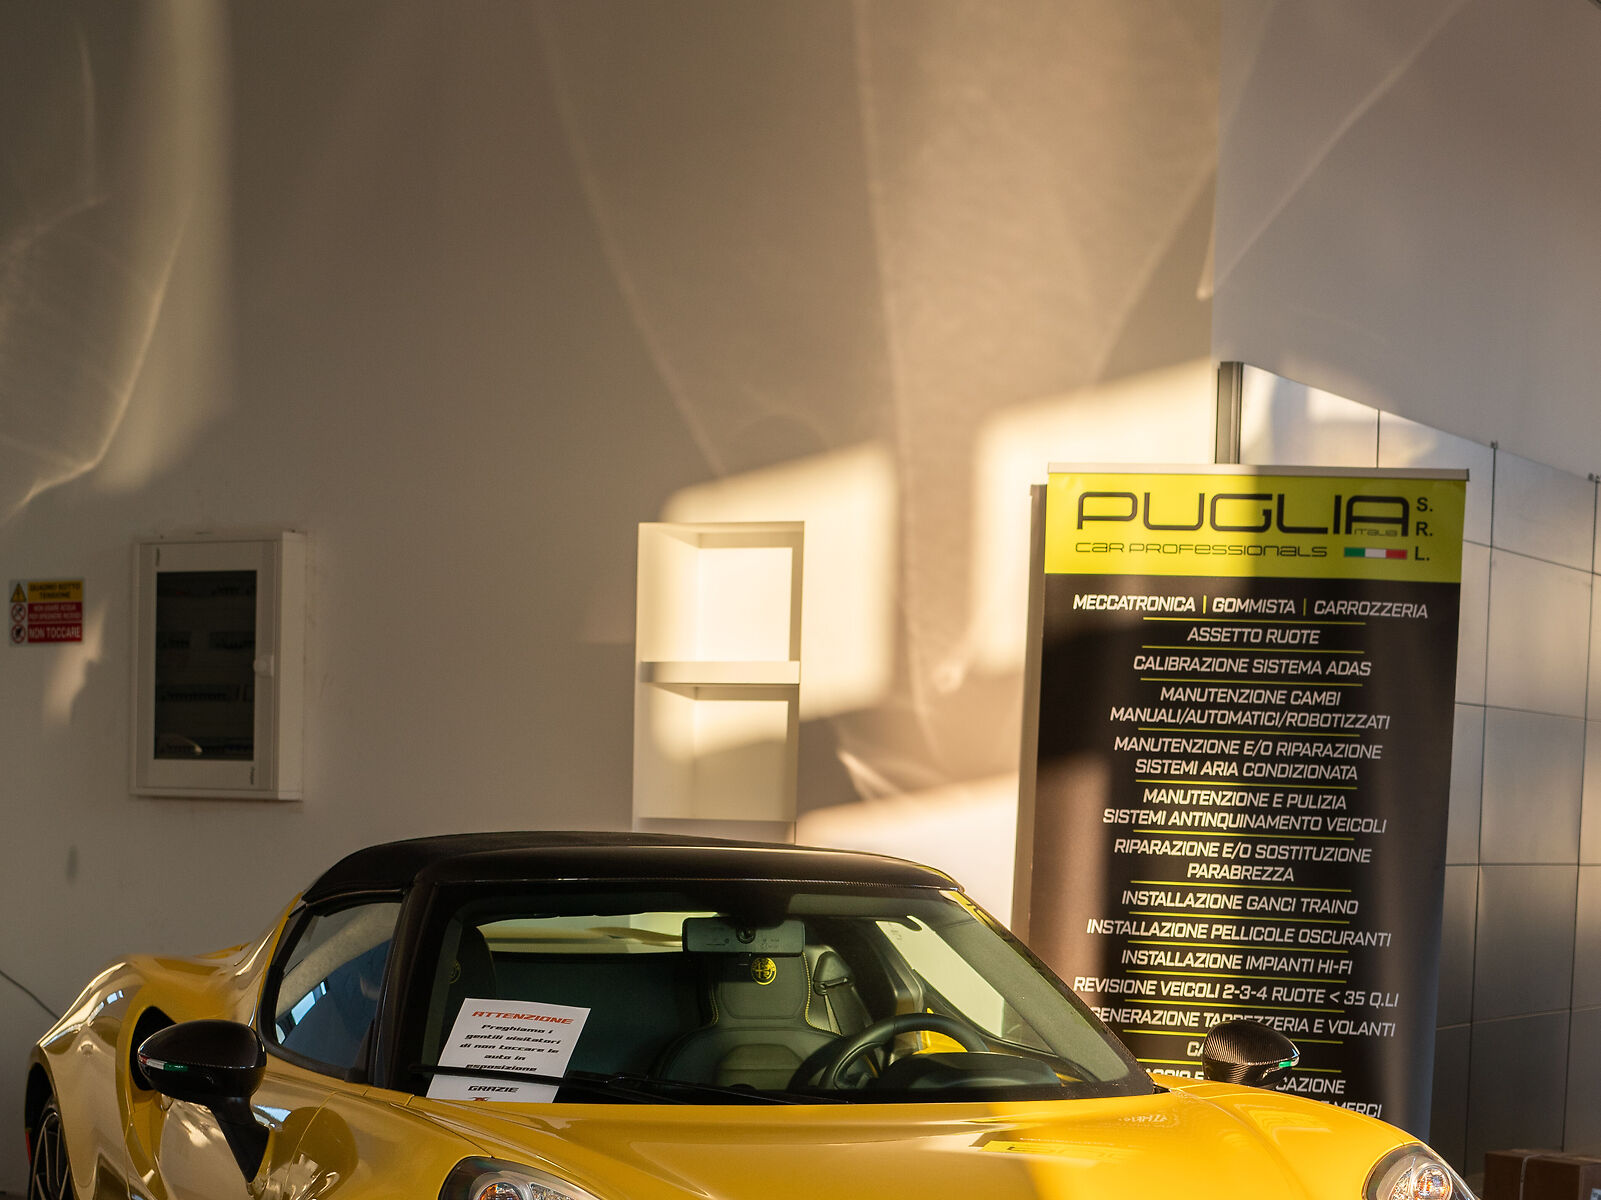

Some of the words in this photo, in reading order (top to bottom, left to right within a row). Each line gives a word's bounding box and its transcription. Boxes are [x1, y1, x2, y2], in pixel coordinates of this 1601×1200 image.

[1077, 492, 1409, 537] PUGLIA
[1073, 594, 1196, 612] MECCATRONICA
[1212, 597, 1296, 614] GOMMISTA
[1314, 600, 1428, 618] CARROZZERIA
[1187, 627, 1262, 642] ASSETTO
[1266, 629, 1320, 644] RUOTE
[1134, 656, 1250, 672] CALIBRAZIONE
[1252, 659, 1322, 674] SISTEMA
[1326, 661, 1372, 676] ADAS
[1160, 687, 1288, 704] MANUTENZIONE
[1290, 690, 1341, 706] CAMBI
[1110, 706, 1390, 730] MANUALI/AUTOMATICI/ROBOTIZZATI
[1114, 736, 1241, 754] MANUTENZIONE
[1243, 739, 1272, 757] E/O
[1276, 742, 1383, 759] RIPARAZIONE
[1135, 759, 1198, 775] SISTEMI
[1200, 761, 1238, 776] ARIA
[1243, 762, 1357, 780] CONDIZIONATA
[1143, 788, 1270, 808] MANUTENZIONE
[1272, 793, 1284, 808] E
[1286, 794, 1346, 810] PULIZIA
[1103, 808, 1167, 825] SISTEMI
[1168, 810, 1322, 831] ANTINQUINAMENTO
[1327, 817, 1387, 833] VEICOLI
[1114, 839, 1220, 859] RIPARAZIONE
[1222, 842, 1252, 860] E/O
[1255, 844, 1372, 863] SOSTITUZIONE
[1187, 863, 1294, 883] PARABREZZA
[1122, 889, 1244, 910] INSTALLAZIONE
[1246, 896, 1296, 912] GANCI
[1300, 898, 1358, 914] TRAINO
[1086, 918, 1210, 942] INSTALLAZIONE
[1208, 924, 1295, 942] PELLICOLE
[1298, 929, 1392, 947] OSCURANTI
[1122, 949, 1243, 971] INSTALLAZIONE
[1246, 956, 1314, 972] IMPIANTI
[1318, 959, 1352, 974] HI-FI
[1074, 977, 1158, 996] REVISIONE
[1160, 980, 1220, 998] VEICOLI
[1222, 984, 1267, 1000] 2-3-4
[1272, 987, 1326, 1003] RUOTE
[1344, 990, 1366, 1005] 35
[472, 1011, 574, 1024] ATTENZIONE
[1313, 1020, 1324, 1034] E
[1327, 1021, 1396, 1037] VOLANTI
[481, 1024, 546, 1034] Preghiamo
[506, 1036, 562, 1044] visitatori
[465, 1064, 537, 1072] esposizione
